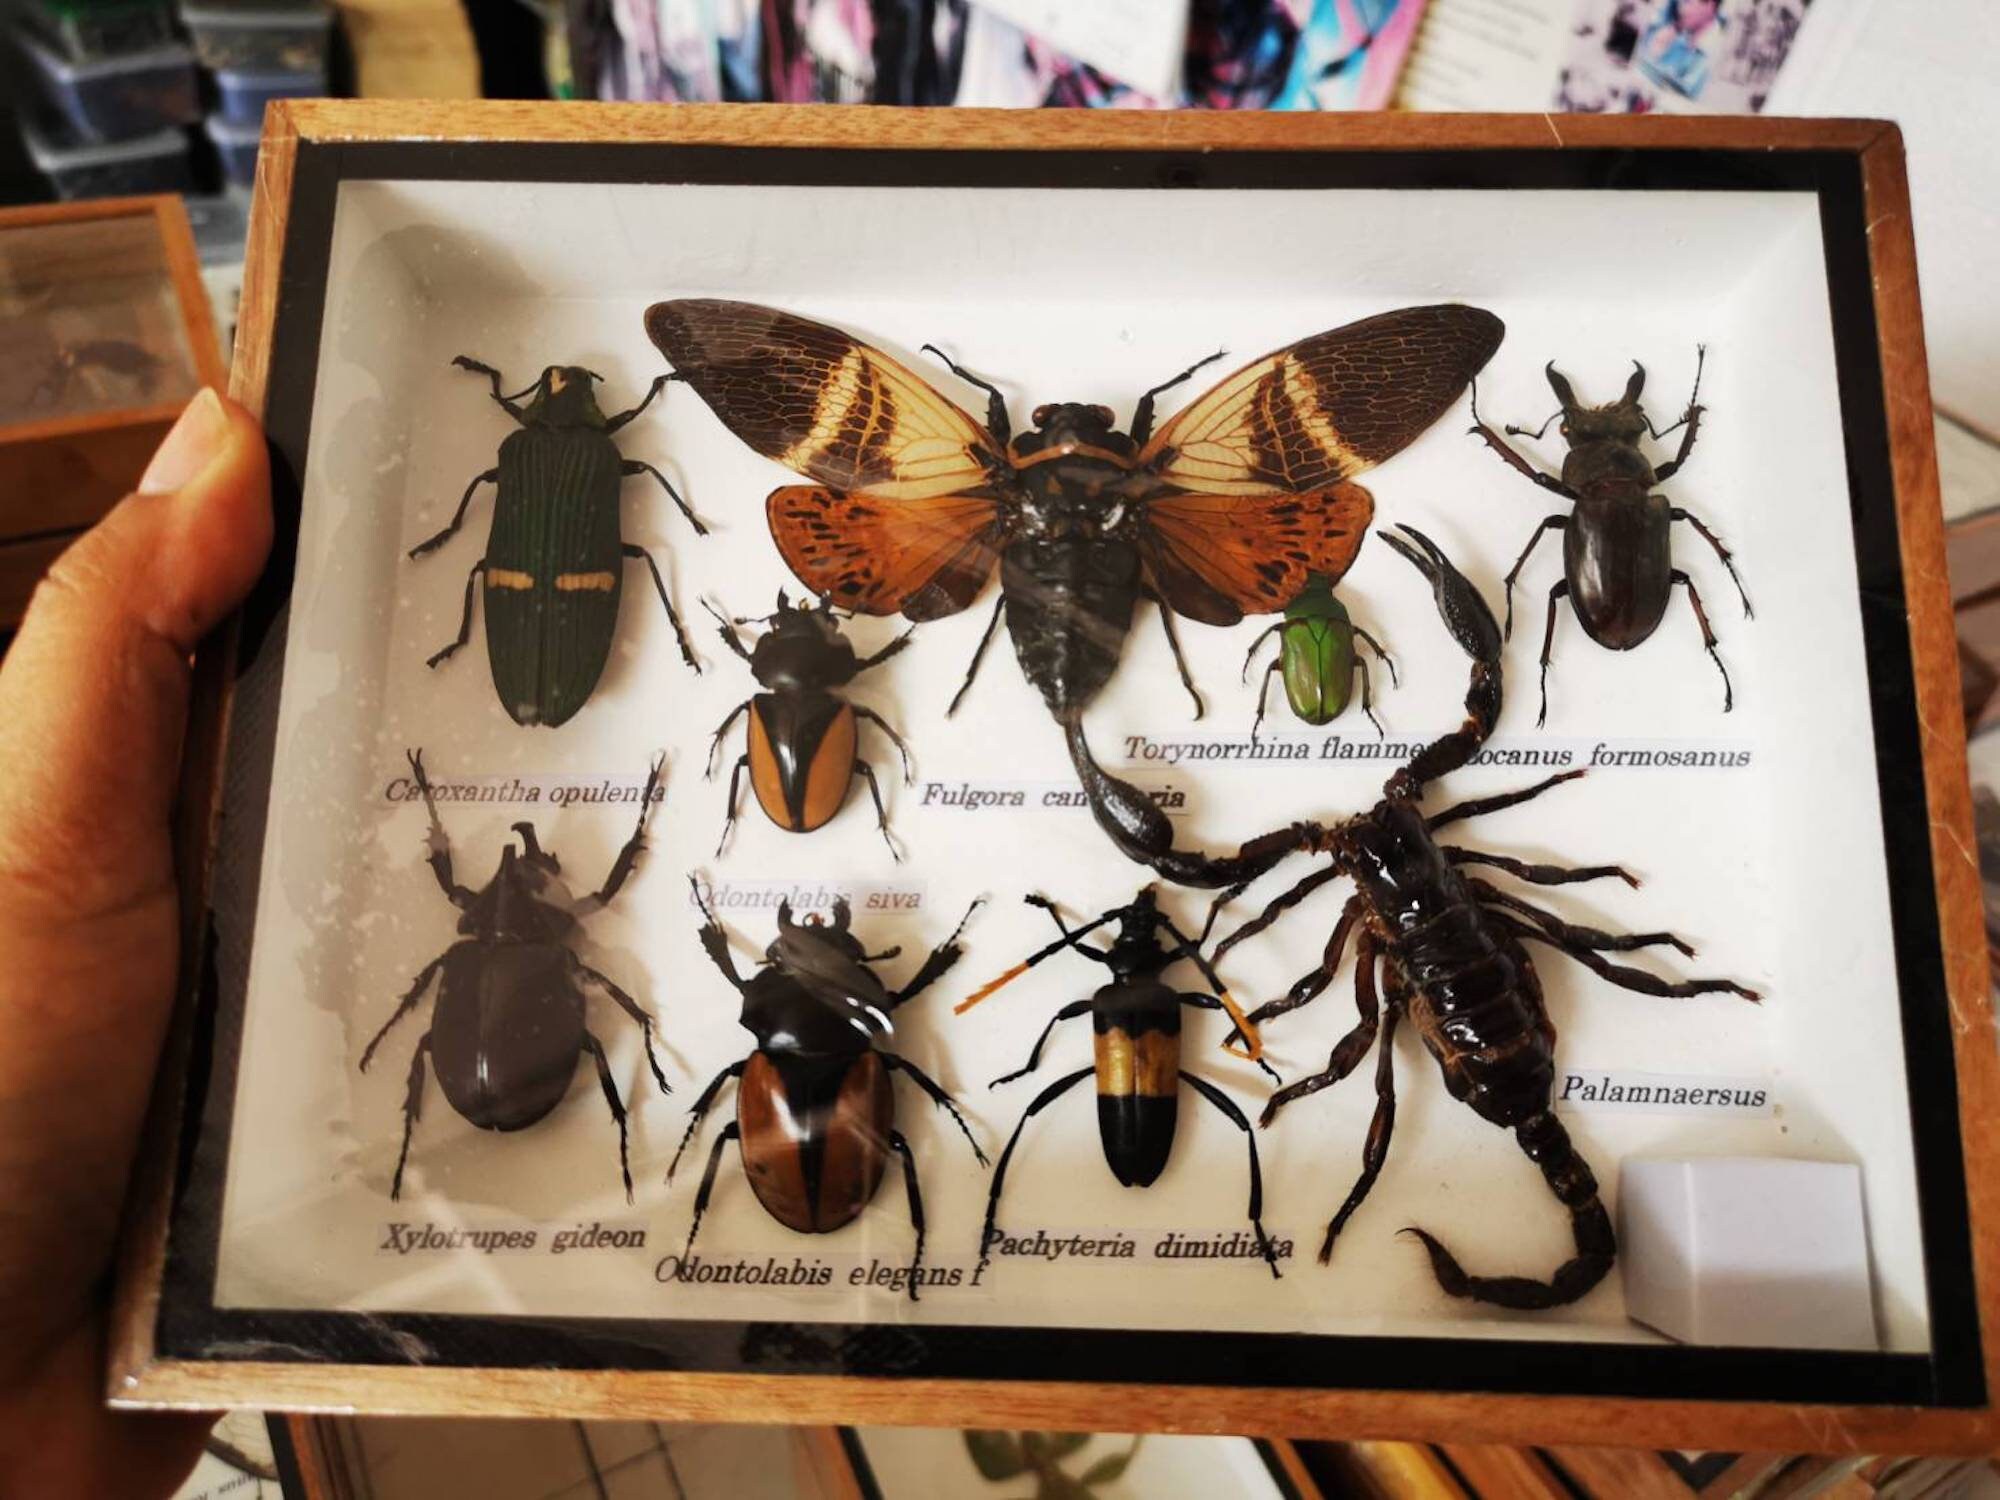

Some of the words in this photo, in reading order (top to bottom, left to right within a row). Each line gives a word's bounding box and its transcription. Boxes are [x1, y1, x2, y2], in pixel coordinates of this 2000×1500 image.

[1124, 735, 1309, 764] Torynorrhina
[1318, 735, 1428, 759] flamme
[1588, 742, 1750, 767] formosanus
[921, 783, 1025, 810] Fulgora
[1042, 786, 1186, 807] canria
[866, 886, 921, 910] siva
[1560, 1075, 1767, 1107] Palamnaersus
[380, 1222, 537, 1254] Xylotrupes
[550, 1222, 646, 1253] gideon
[980, 1228, 1136, 1260] Pachyteria
[654, 1255, 833, 1285] Odontolabis
[848, 1259, 962, 1291] elegans
